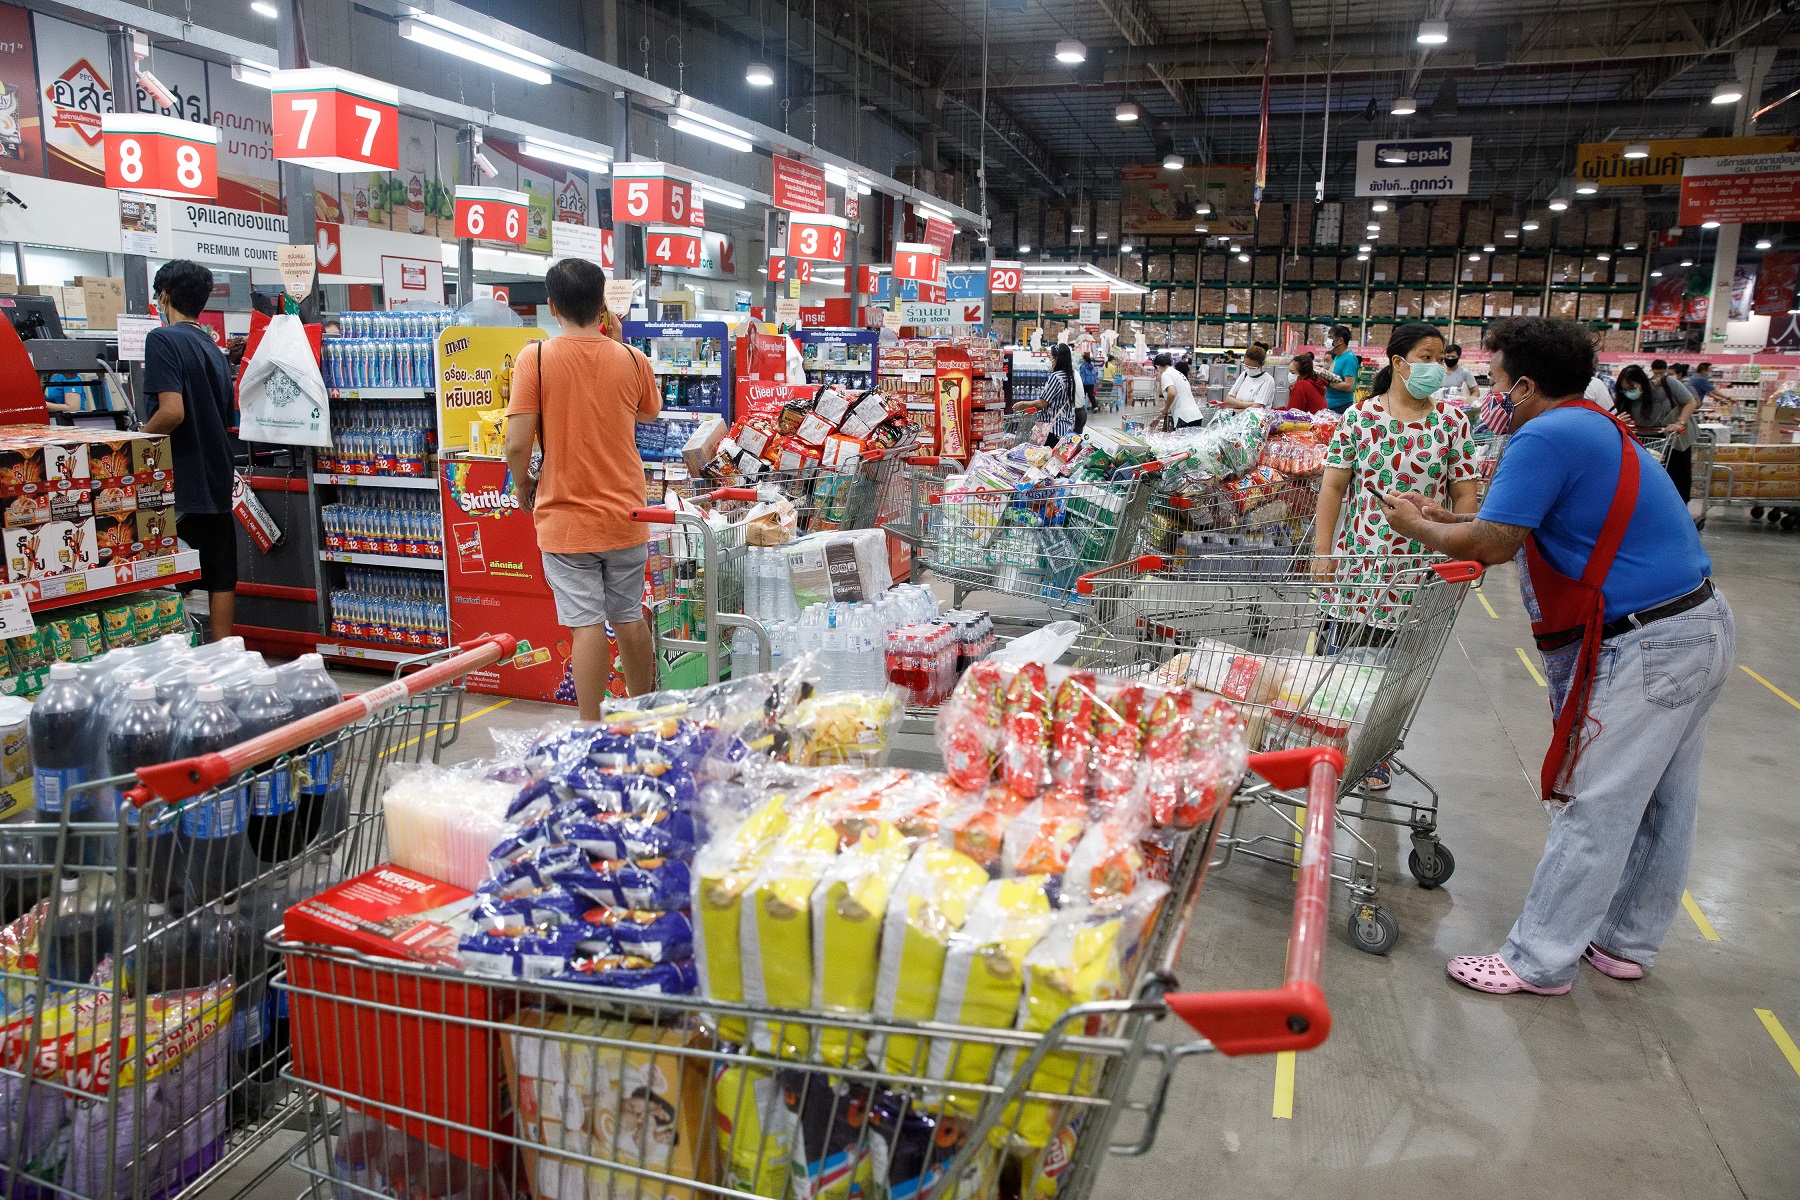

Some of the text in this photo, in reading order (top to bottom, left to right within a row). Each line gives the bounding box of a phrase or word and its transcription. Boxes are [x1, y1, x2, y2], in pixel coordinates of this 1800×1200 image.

[291, 99, 318, 150] 7
[355, 105, 381, 157] 7
[119, 139, 143, 182] 8
[1378, 147, 1449, 162] Sepak
[176, 145, 202, 188] 8
[627, 183, 649, 216] 5
[671, 186, 684, 220] 5
[468, 205, 485, 234] 6
[506, 207, 519, 238] 6
[197, 242, 278, 261] PREMIUM COUNTE
[656, 237, 671, 261] 4
[686, 240, 695, 263] 4
[800, 227, 817, 254] 3
[832, 231, 841, 257] 3
[777, 260, 785, 279] 2
[801, 262, 809, 280] 2
[907, 255, 917, 277] 1
[932, 257, 936, 279] 1
[870, 275, 878, 293] 21
[992, 270, 1017, 289] 20
[906, 305, 951, 316] ร้านยา
[908, 316, 927, 324] drug
[445, 387, 492, 408] หยิบเลย
[750, 385, 788, 400] Cheer up
[460, 489, 519, 512] Skittles
[255, 530, 270, 549] PLEASE
[374, 869, 436, 893] NESCAFÉ
